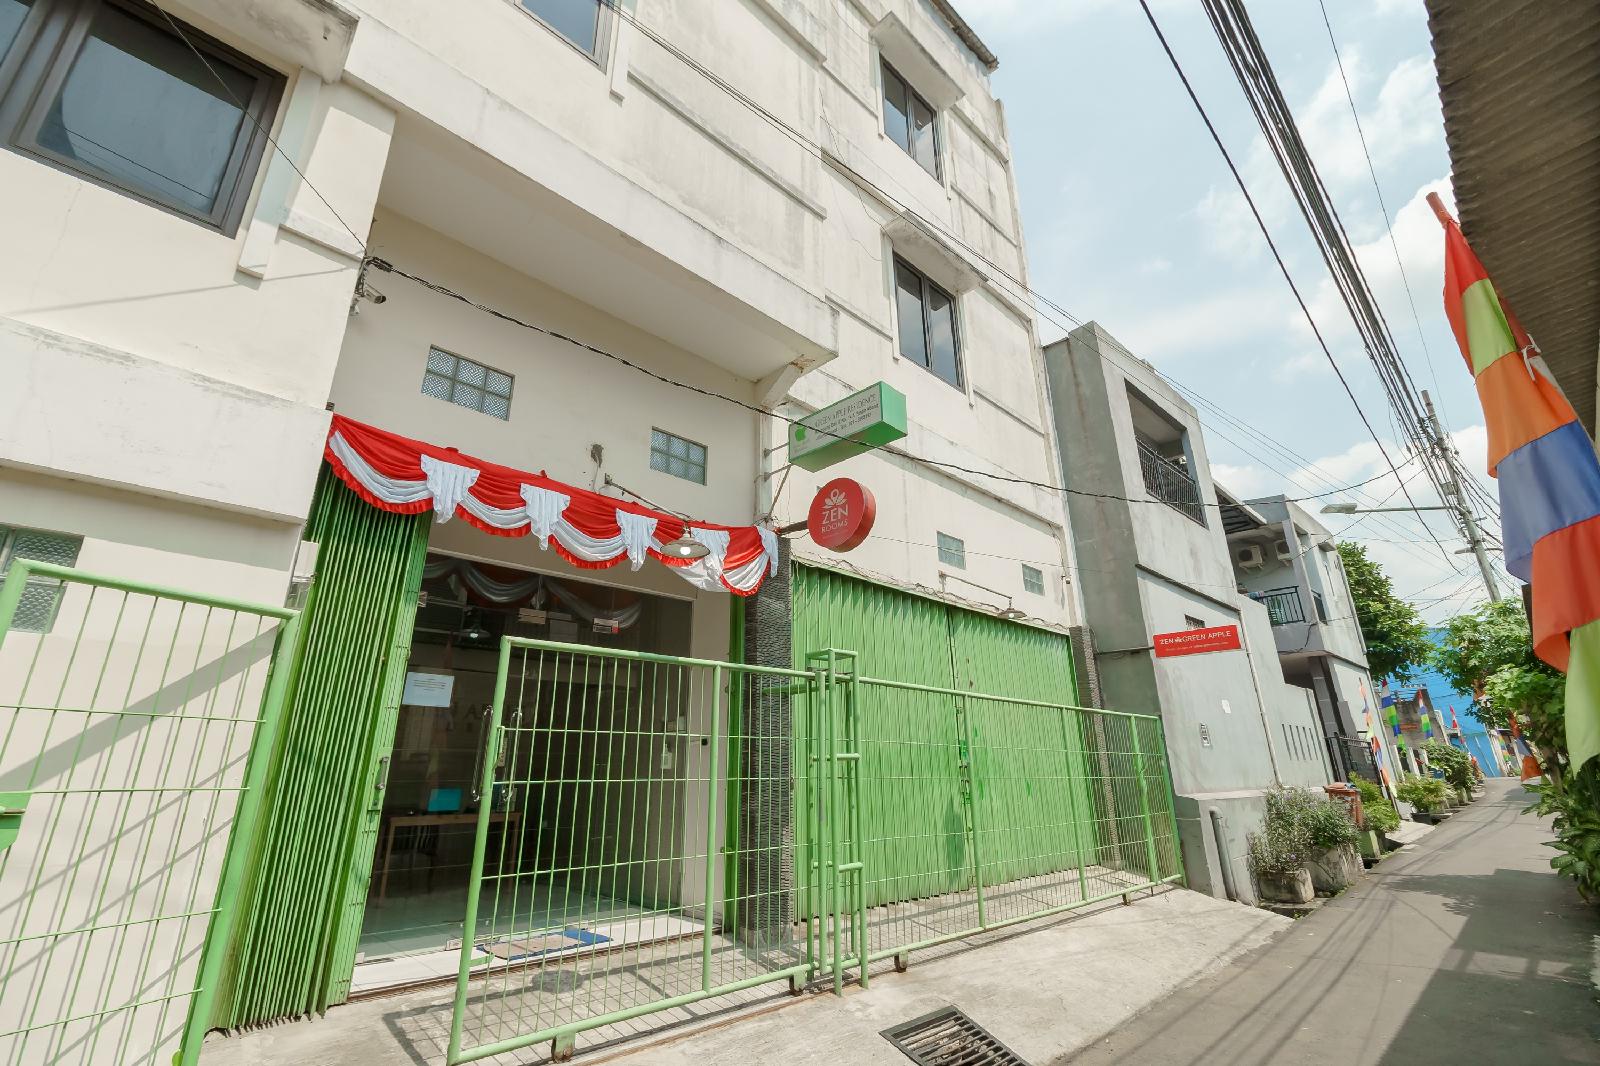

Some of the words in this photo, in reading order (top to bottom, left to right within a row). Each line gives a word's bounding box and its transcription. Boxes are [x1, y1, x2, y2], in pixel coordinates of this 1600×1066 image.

[821, 503, 849, 525] ZEN
[821, 520, 849, 534] ROOMS
[1182, 634, 1206, 643] GREEN
[1207, 630, 1232, 639] APPLE
